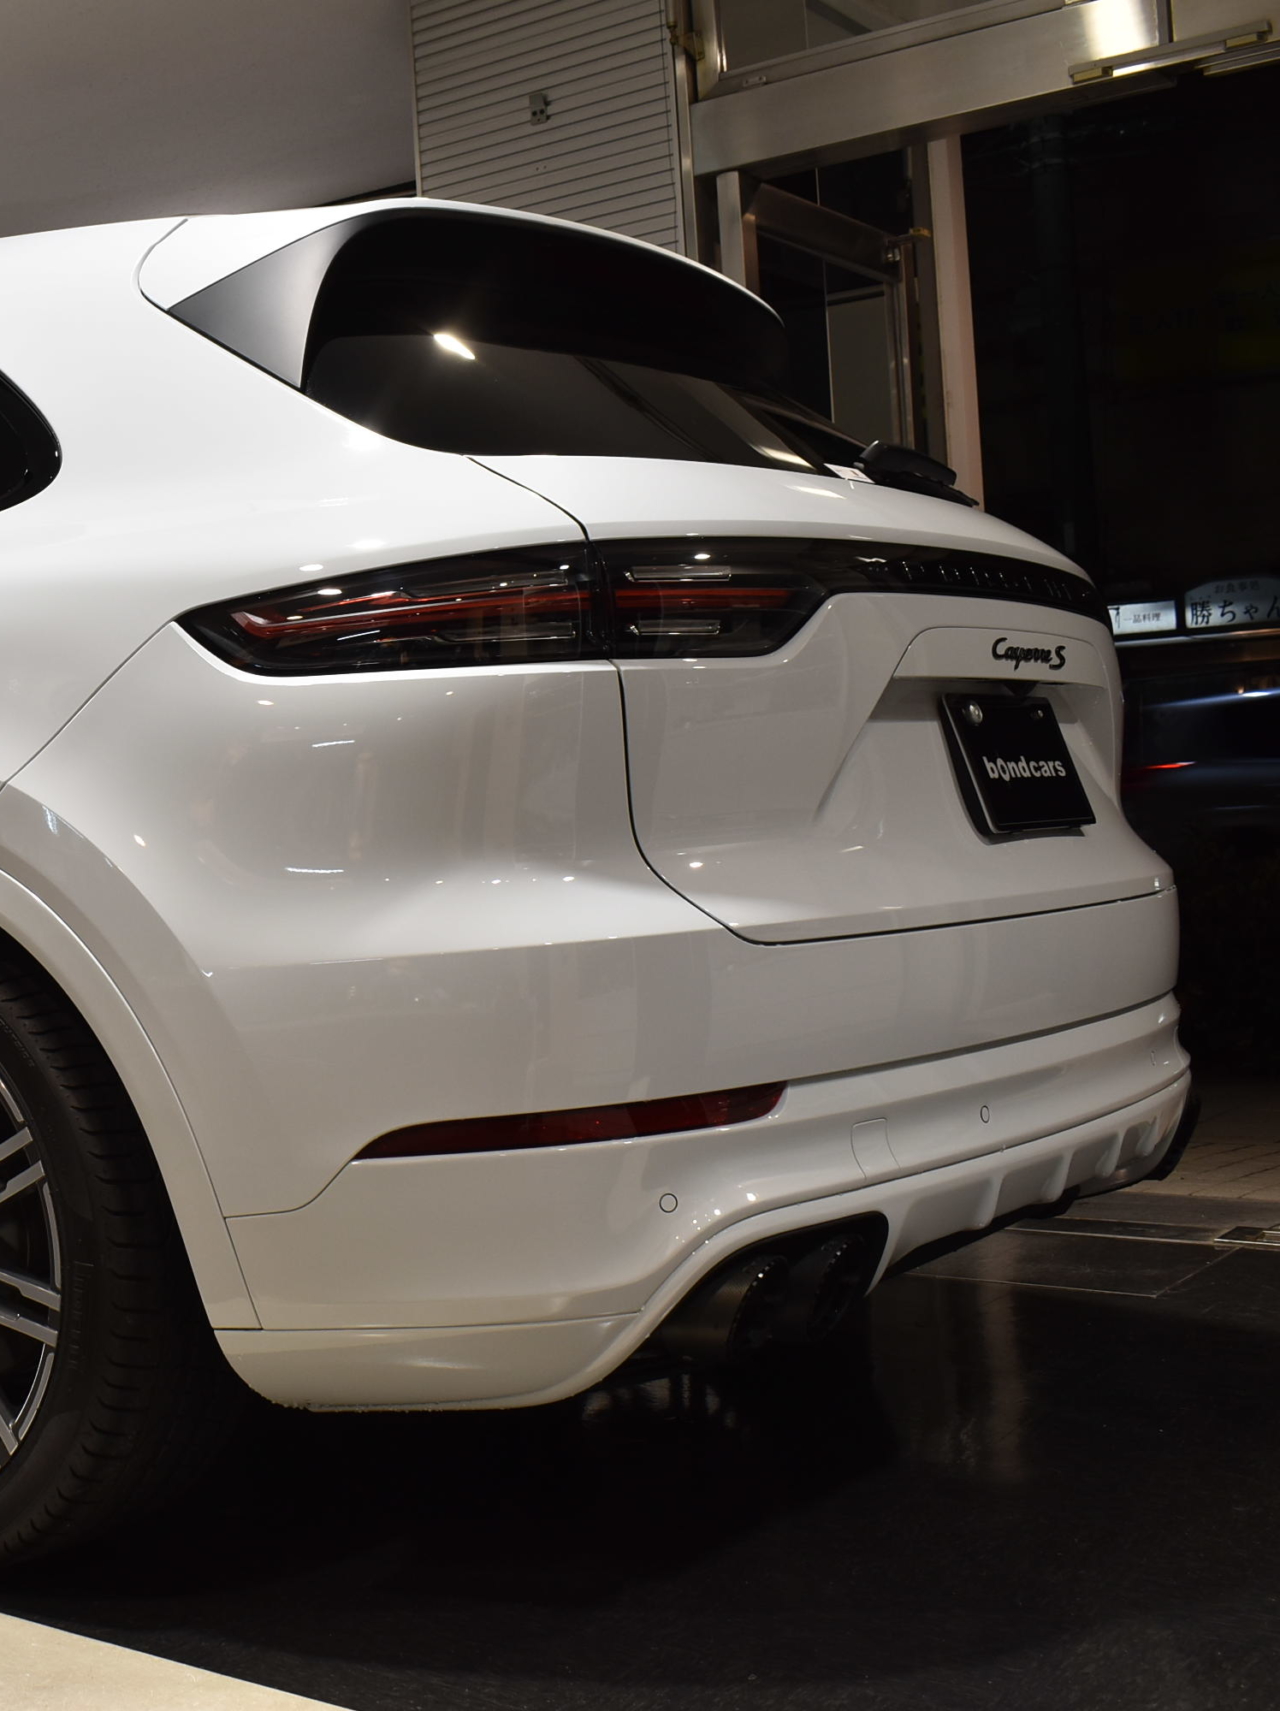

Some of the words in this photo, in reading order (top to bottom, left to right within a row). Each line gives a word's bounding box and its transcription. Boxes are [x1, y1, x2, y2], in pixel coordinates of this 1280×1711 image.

[1123, 612, 1162, 624] 一品料理
[1190, 596, 1280, 626] 勝ちゃん
[991, 637, 1053, 672] Cayenne
[1048, 645, 1066, 670] S
